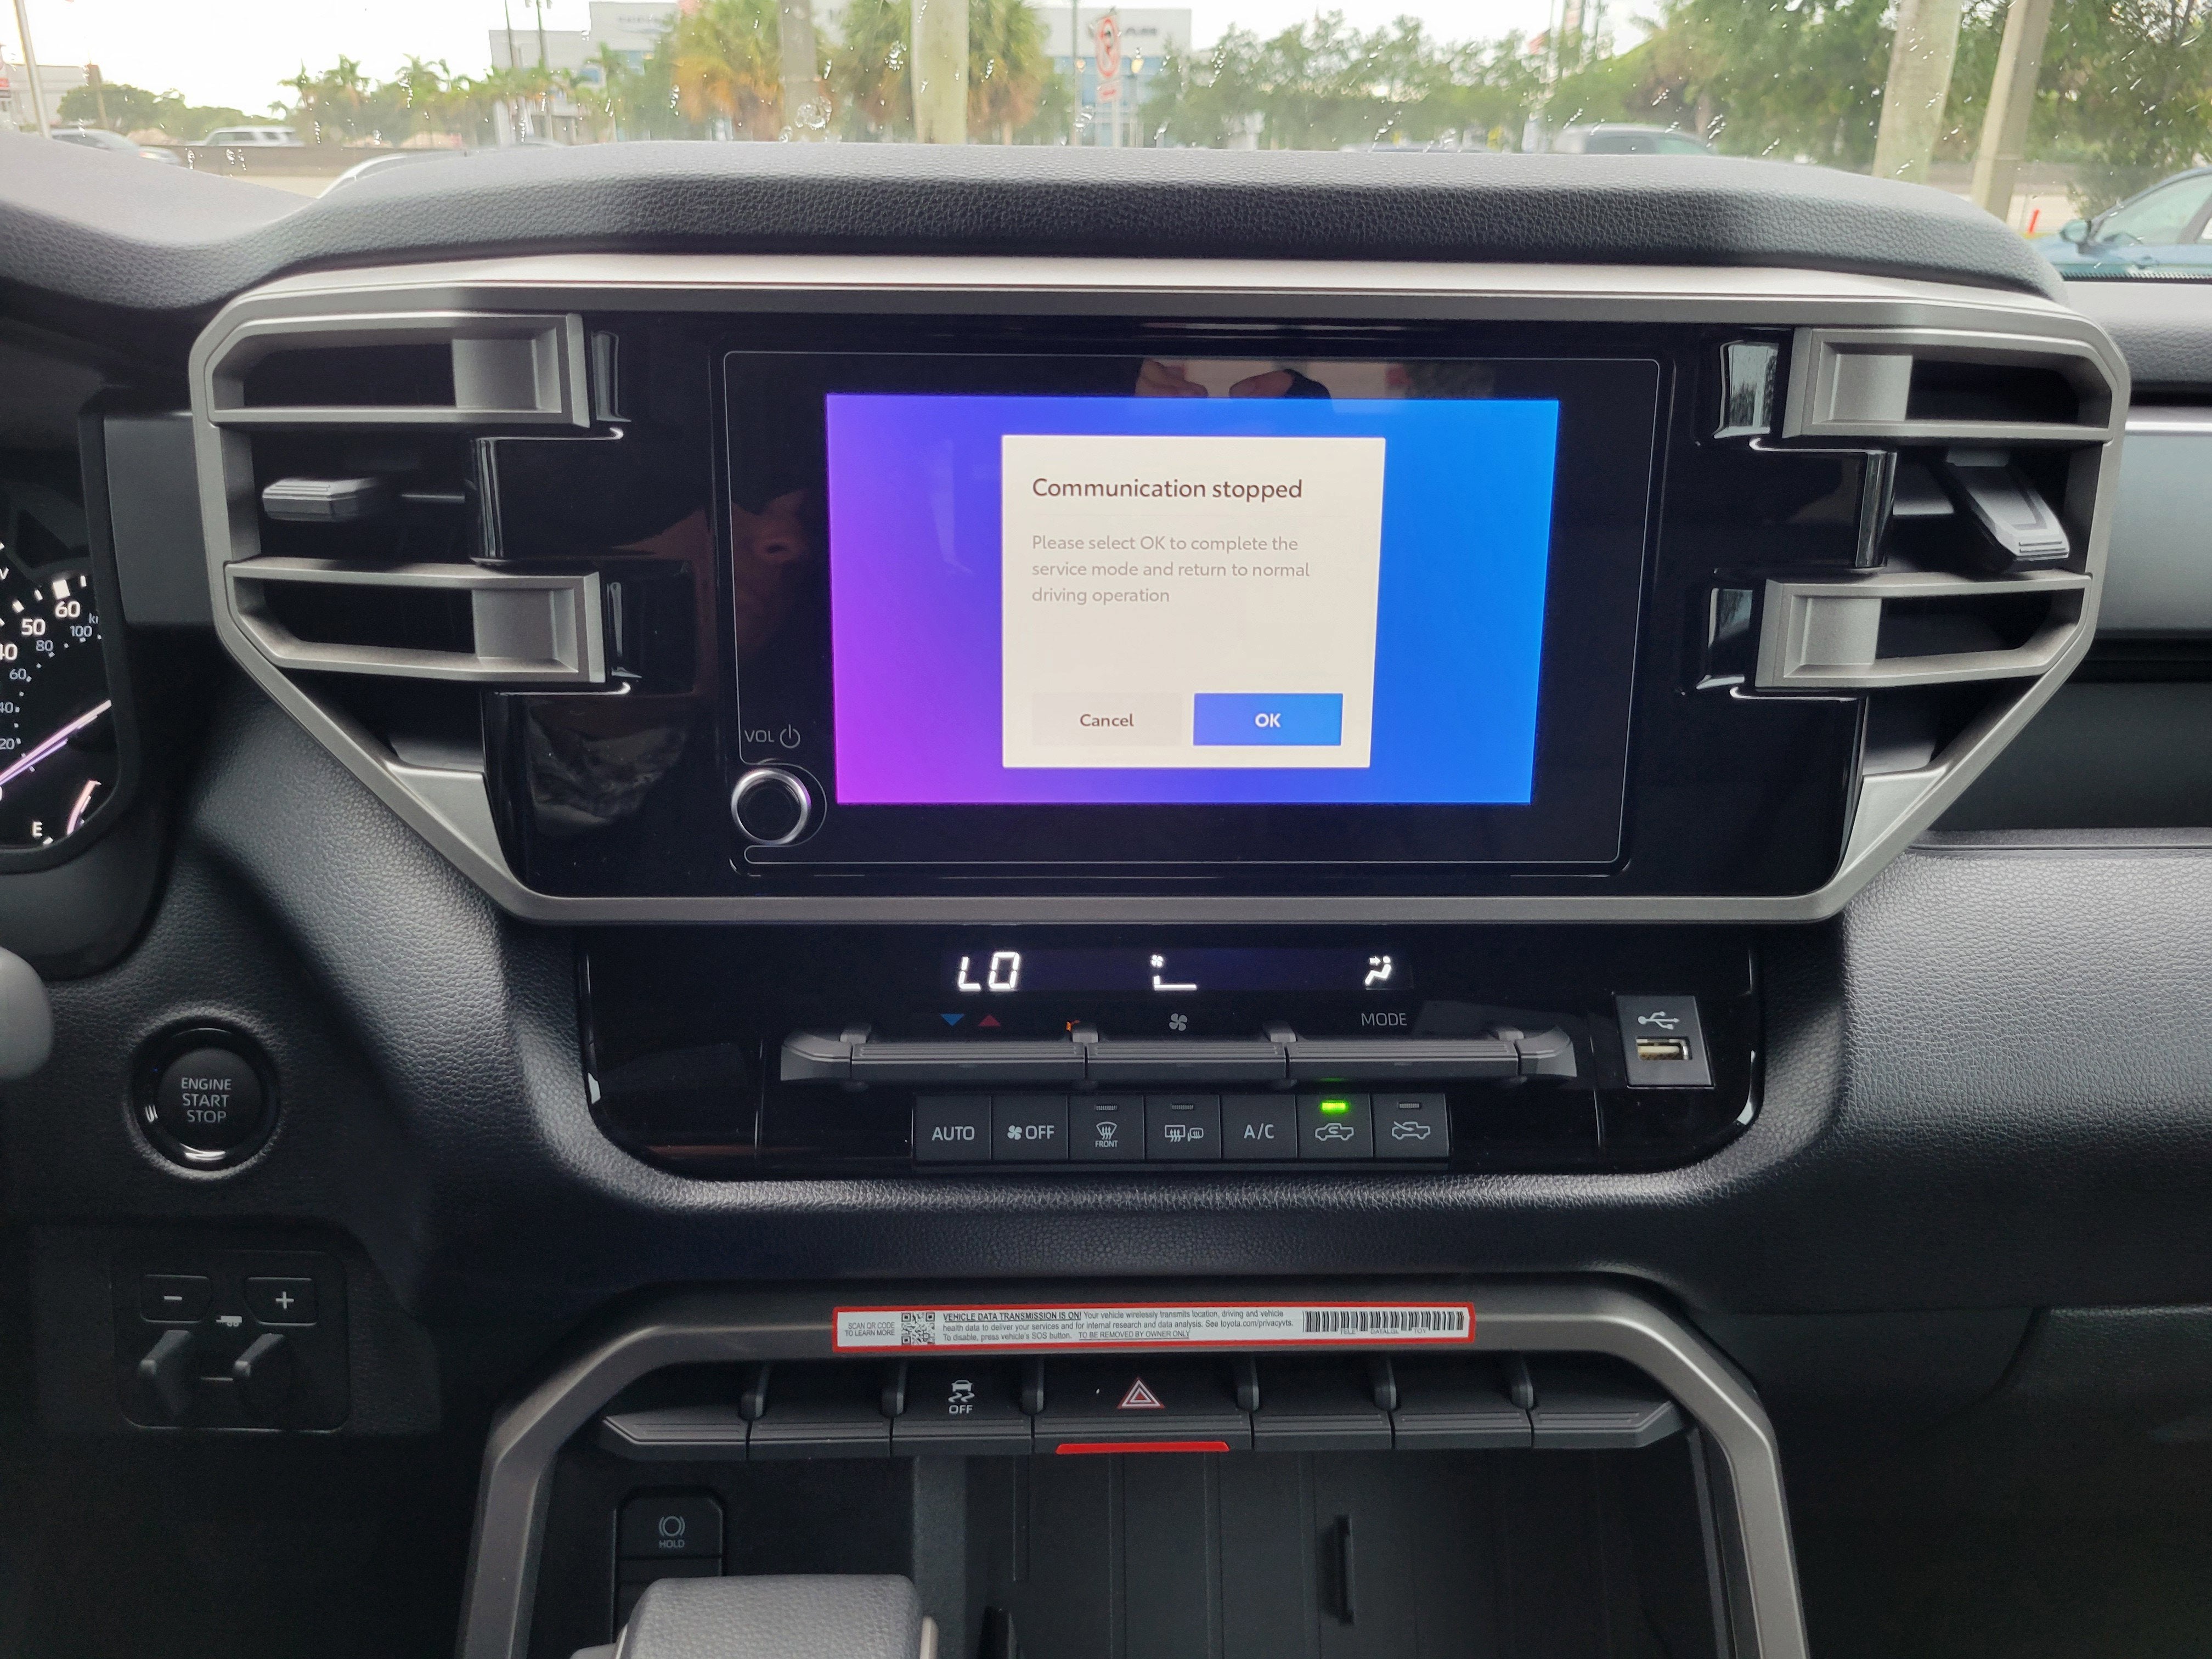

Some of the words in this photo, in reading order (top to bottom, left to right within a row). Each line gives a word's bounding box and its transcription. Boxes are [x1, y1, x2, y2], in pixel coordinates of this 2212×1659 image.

[1032, 478, 1206, 498] Communication
[1212, 479, 1302, 503] stopped
[1032, 535, 1084, 551] Please
[1088, 535, 1136, 551] select
[1140, 536, 1165, 551] OK
[1170, 537, 1187, 551] to
[1190, 536, 1267, 554] complete
[1272, 537, 1298, 551] the
[1032, 562, 1087, 576] service
[1092, 562, 1138, 577] mode
[1143, 562, 1173, 577] and
[1178, 564, 1226, 577] return
[1232, 563, 1248, 577] to
[1252, 562, 1310, 577] normal
[1032, 588, 1087, 606] driving
[1092, 589, 1170, 605] operation
[55, 601, 81, 618] 60
[21, 618, 46, 636] 50
[69, 625, 93, 637] 100
[36, 640, 53, 651] 80
[9, 668, 27, 680] 60
[1079, 713, 1135, 727] Cancel
[1254, 713, 1281, 728] OK
[744, 730, 775, 742] VOL
[0, 738, 15, 750] 20
[31, 821, 43, 838] E
[1361, 1013, 1407, 1026] MODE
[181, 1077, 232, 1090] ENGINE
[183, 1093, 229, 1107] START
[187, 1110, 227, 1123] STOP
[932, 1126, 975, 1141] AUTO
[1025, 1125, 1055, 1139] OFF
[1243, 1123, 1274, 1139] A/C
[943, 1312, 975, 1321] VEHICLE
[978, 1312, 997, 1321] DATA
[1000, 1312, 1057, 1321] TRANSMISSION
[1059, 1311, 1065, 1320] IS
[1084, 1311, 1098, 1319] Your
[1126, 1310, 1158, 1320] wirelessly
[1221, 1310, 1244, 1319] driving
[1113, 1321, 1141, 1329] research
[1143, 1320, 1155, 1328] and
[1175, 1319, 1203, 1329] analysis.
[943, 1333, 951, 1341] To
[980, 1334, 999, 1342] press
[1032, 1331, 1047, 1340] SOS
[1049, 1331, 1072, 1339] button.
[949, 1404, 973, 1414] OFF
[659, 1539, 685, 1548] HOLD
